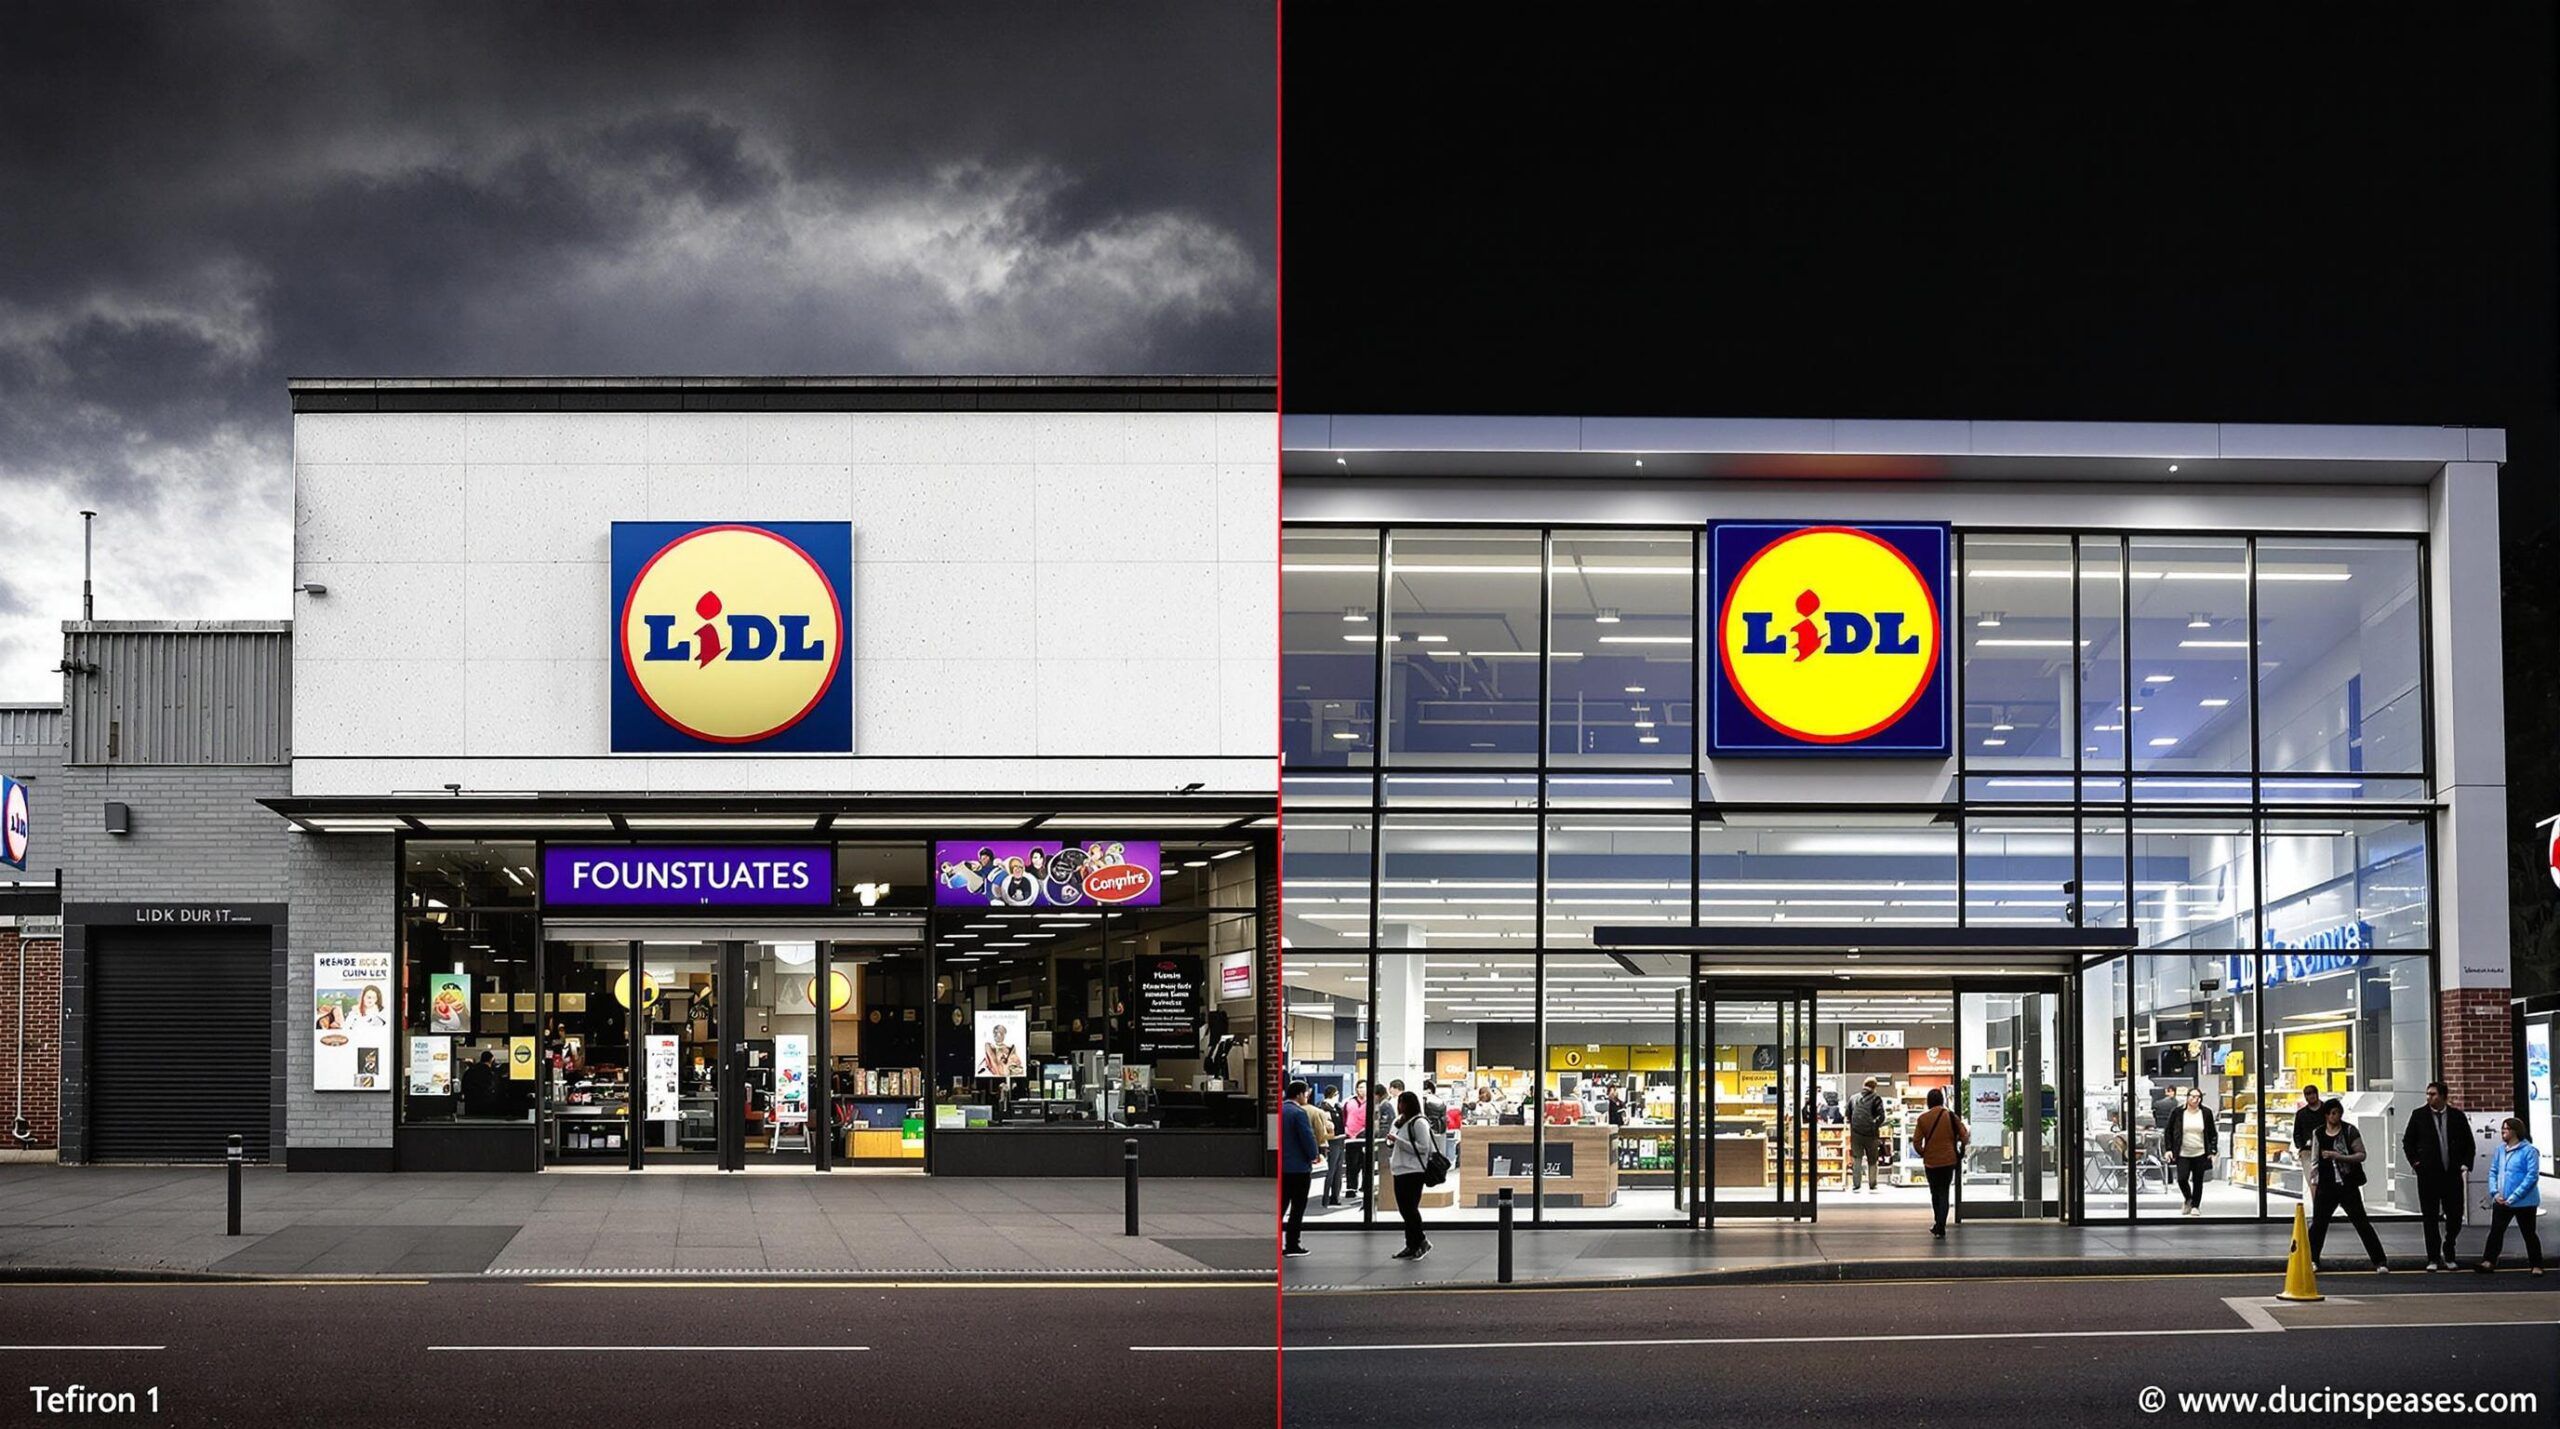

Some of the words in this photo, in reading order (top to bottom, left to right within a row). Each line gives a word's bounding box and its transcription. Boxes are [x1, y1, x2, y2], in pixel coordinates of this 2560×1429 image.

[573, 861, 809, 889] FOUNSTUATES
[136, 908, 175, 922] LIDK
[180, 908, 211, 922] DUR
